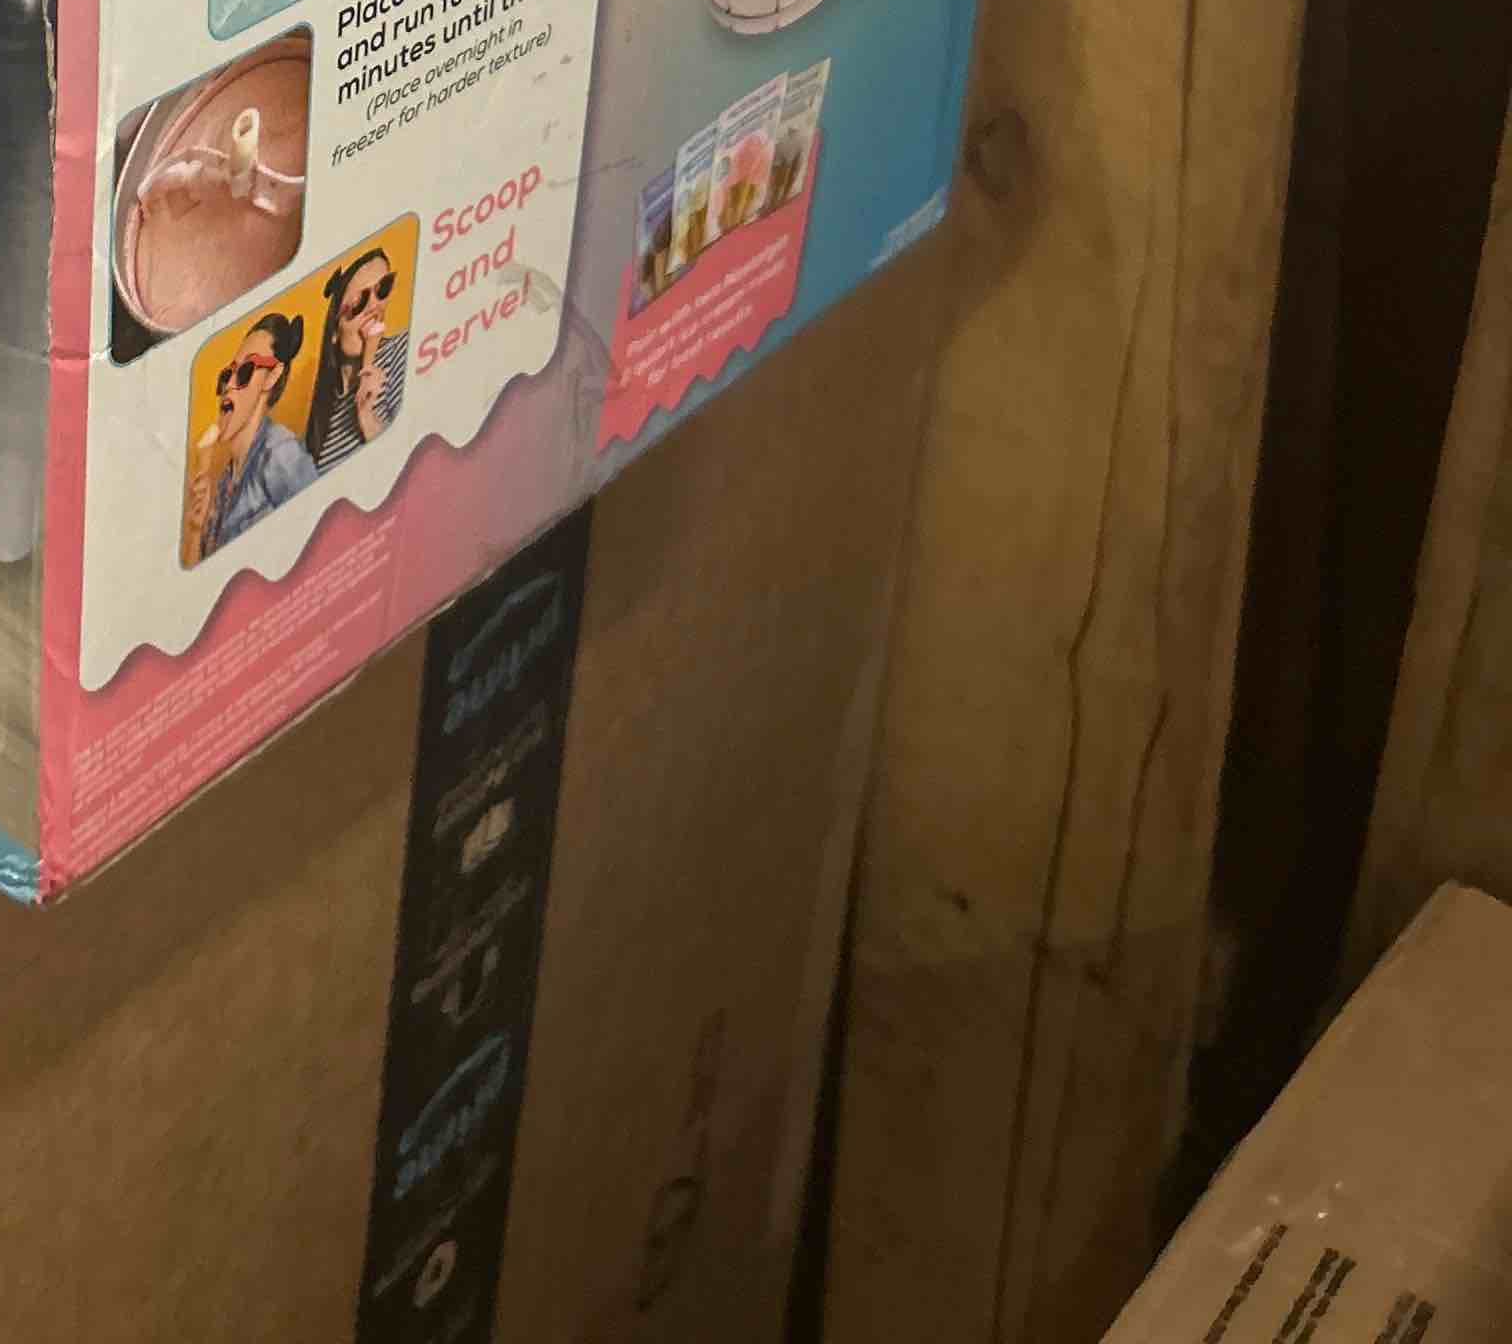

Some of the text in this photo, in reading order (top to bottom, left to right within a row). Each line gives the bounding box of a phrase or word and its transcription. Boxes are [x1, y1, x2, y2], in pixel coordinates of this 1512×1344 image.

[337, 23, 386, 70] and
[393, 2, 434, 41] run
[338, 32, 436, 104] minutes
[366, 16, 523, 120] (Place overnight in
[332, 23, 552, 167] freezer for harder texture)
[430, 165, 541, 252] Scoop
[445, 224, 516, 300] and
[415, 272, 532, 375] Serve!
